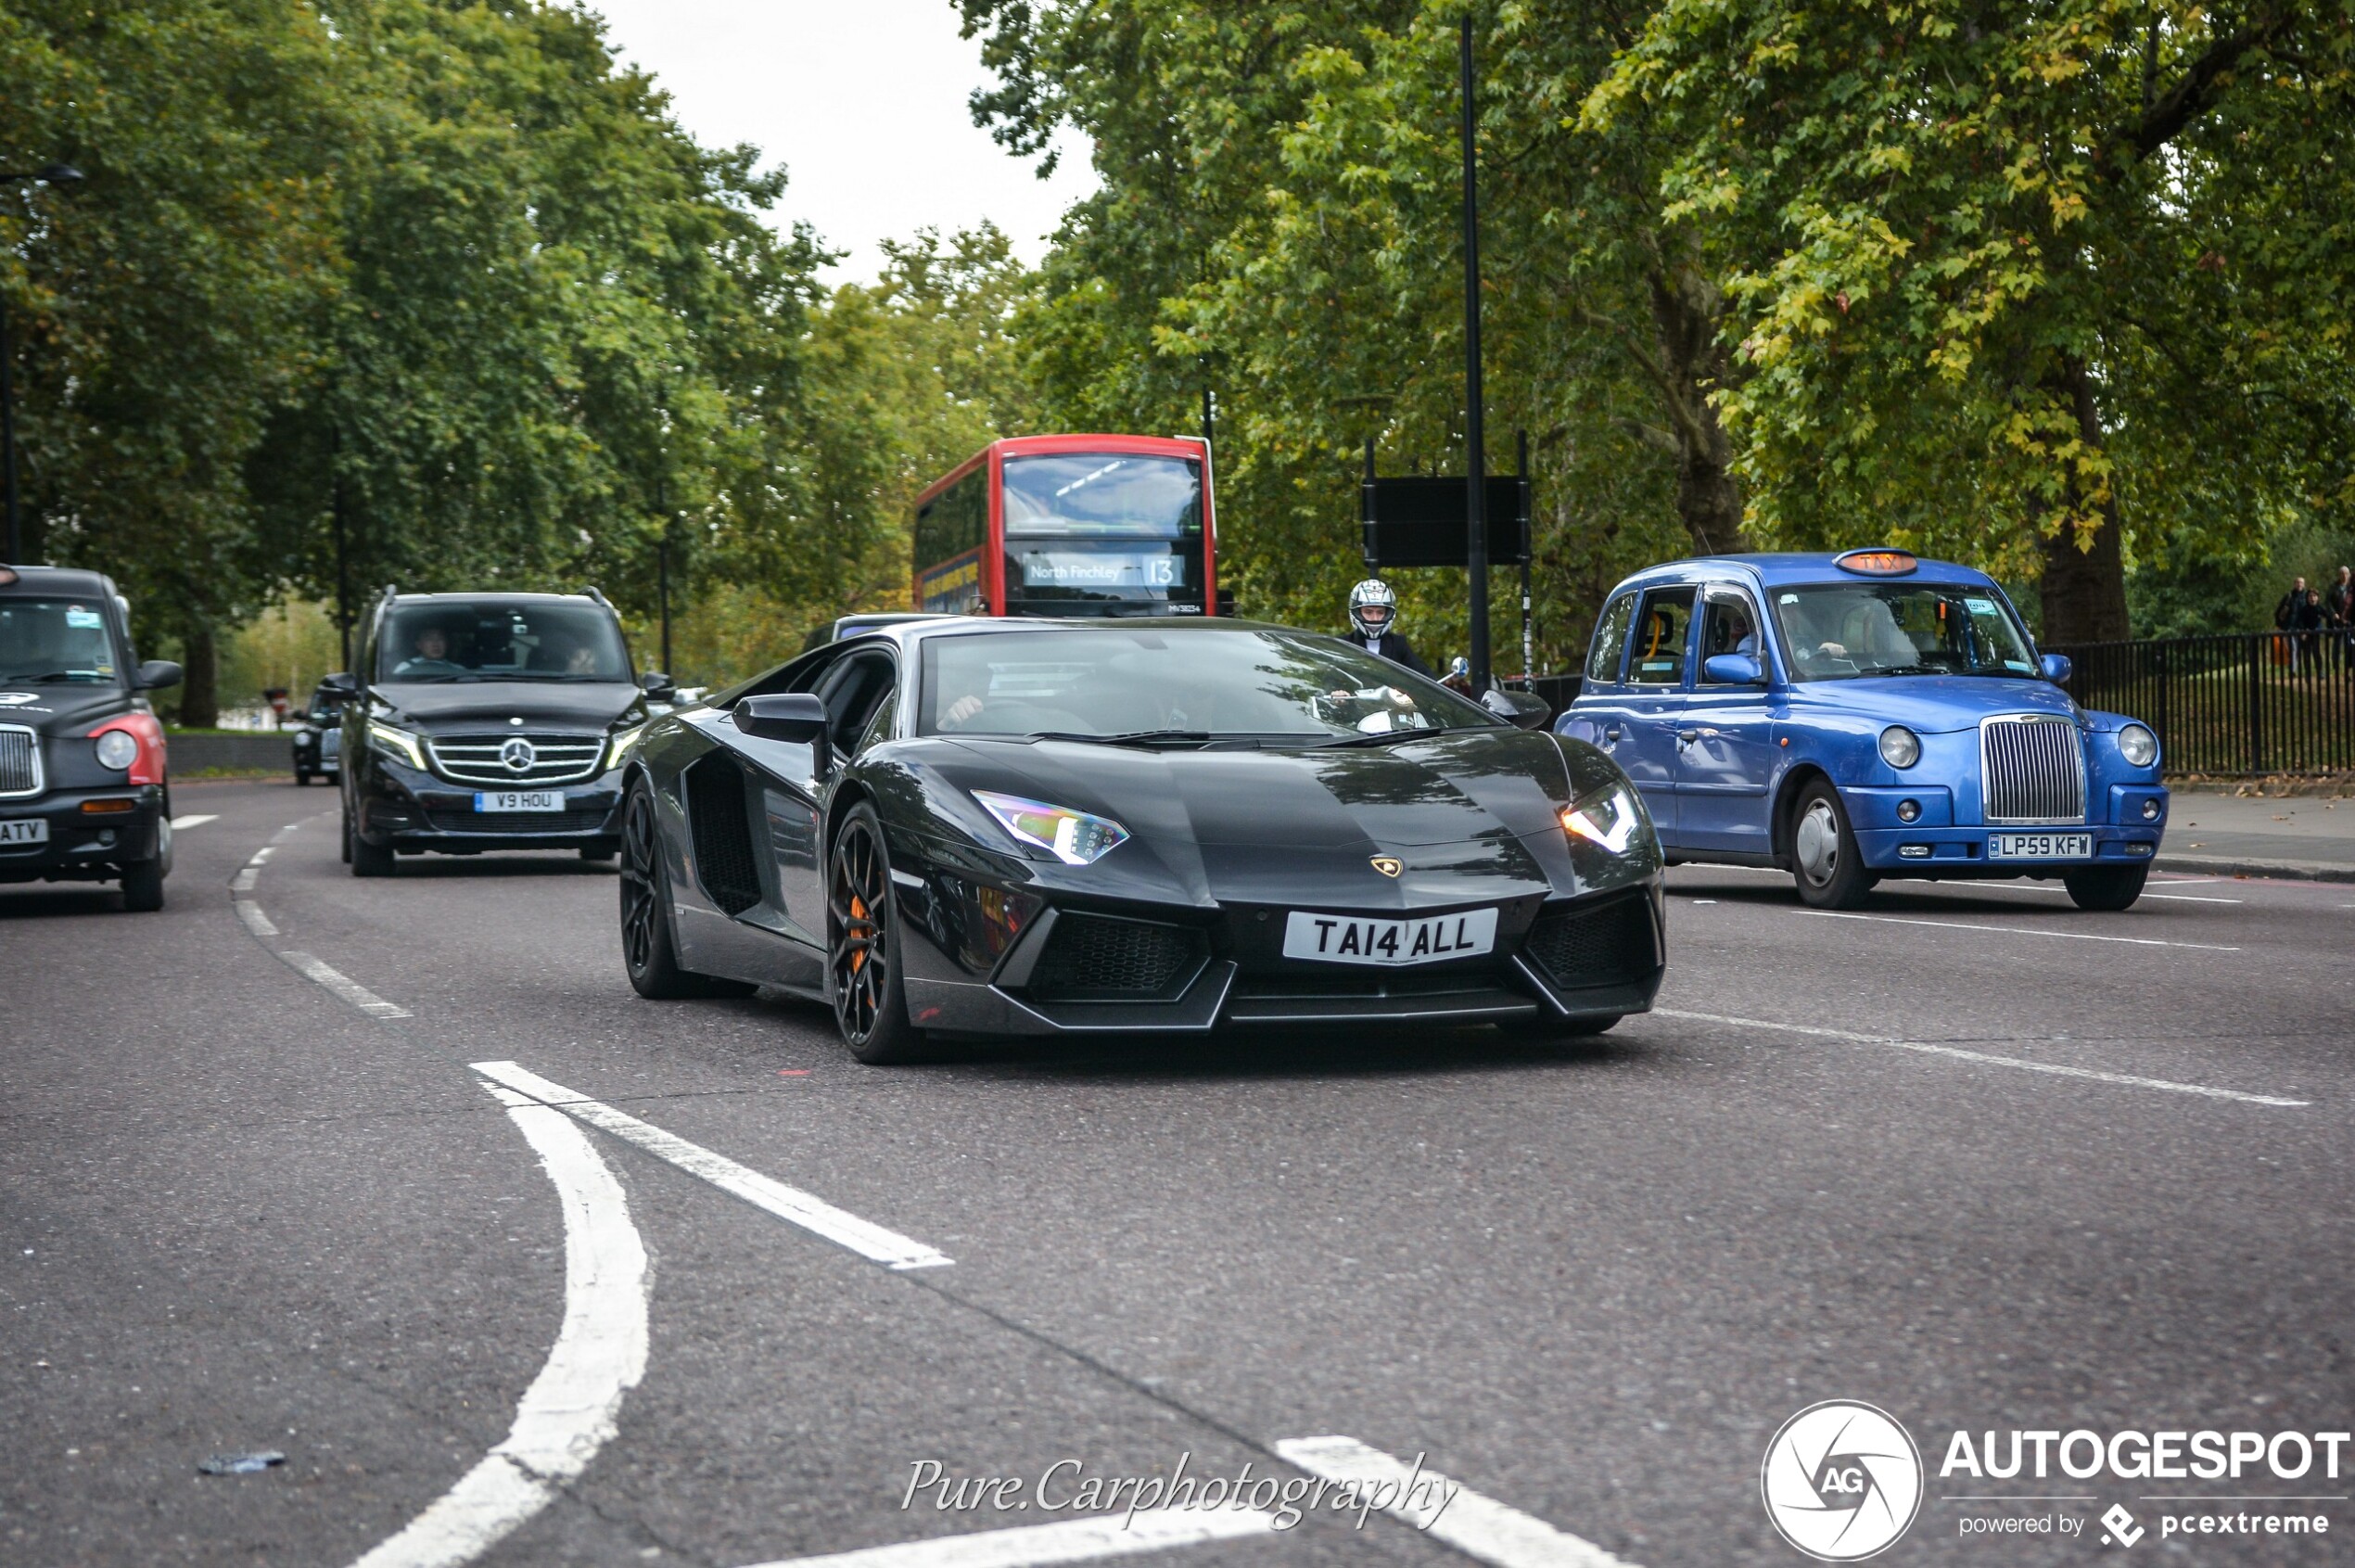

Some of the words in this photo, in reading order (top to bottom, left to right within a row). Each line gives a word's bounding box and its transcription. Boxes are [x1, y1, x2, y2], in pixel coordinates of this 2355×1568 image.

[1150, 560, 1174, 583] 13
[1860, 555, 1904, 570] TAXI
[1030, 565, 1067, 579] North
[1070, 565, 1120, 580] Finchley
[497, 794, 516, 808] V9
[521, 794, 551, 808] HOU
[0, 822, 39, 840] ATV
[2002, 836, 2051, 855] LP59
[2056, 836, 2088, 854] KFW
[1314, 919, 1400, 958] TA14
[1410, 917, 1475, 957] ALL
